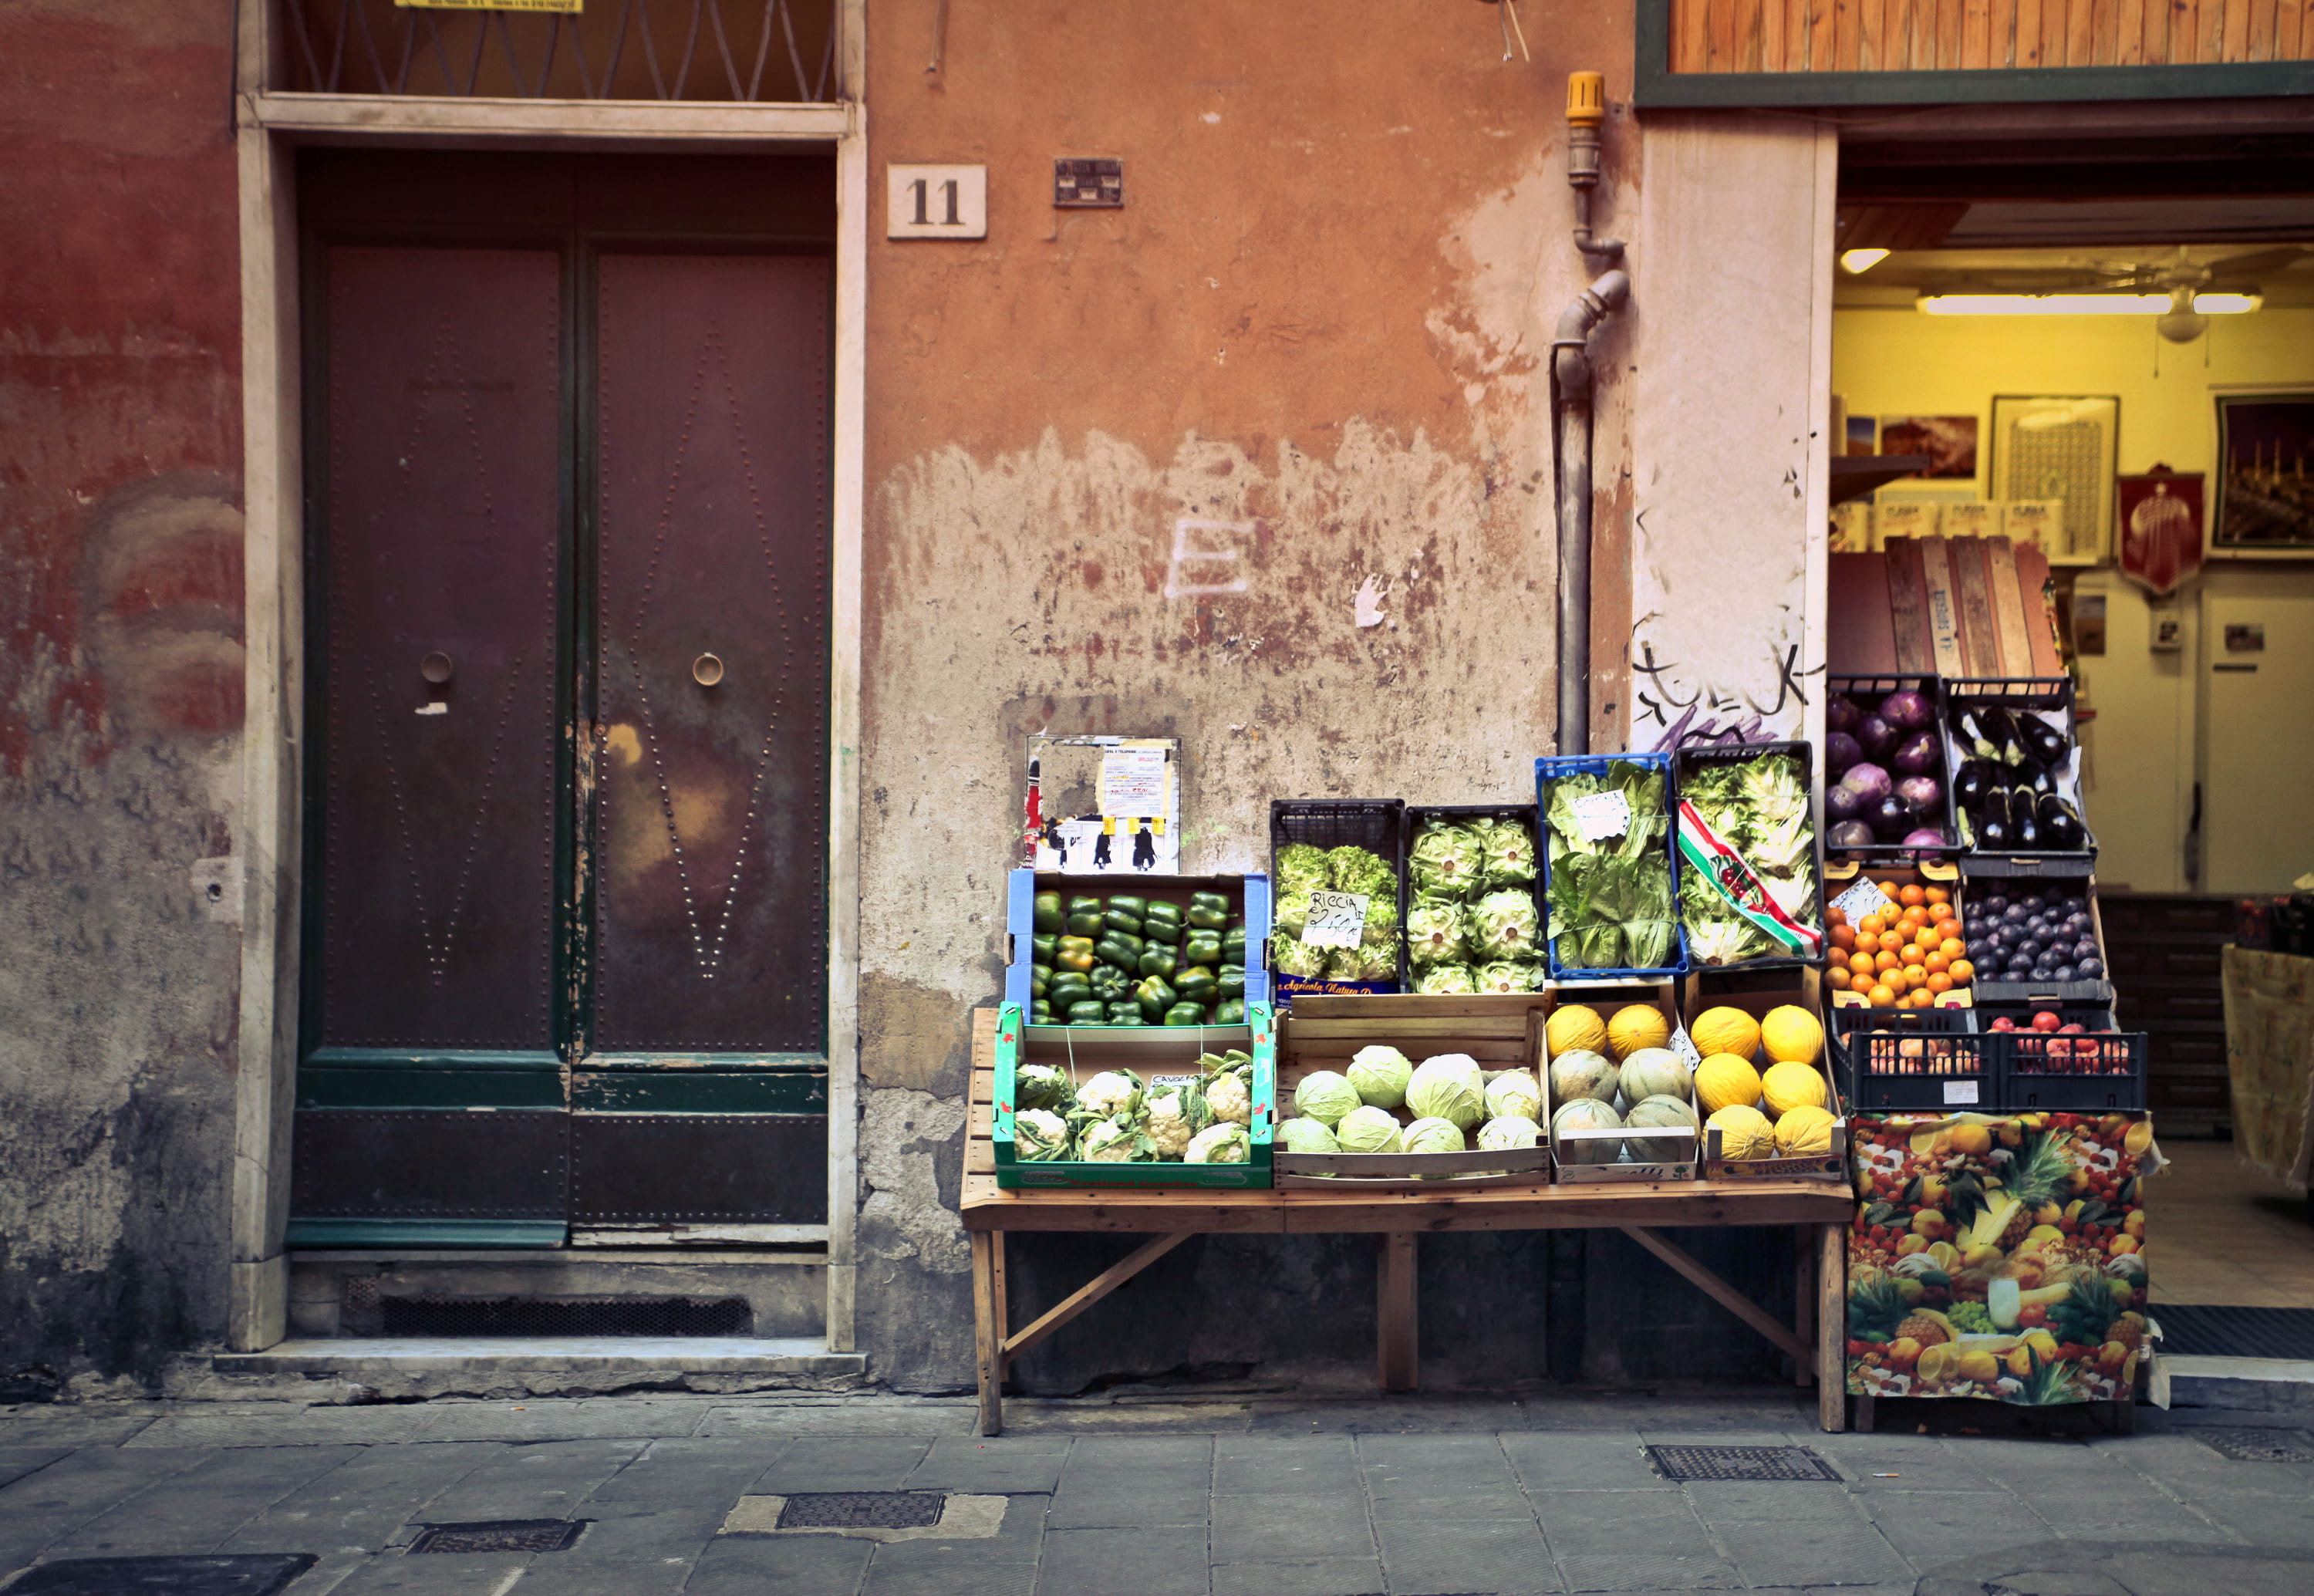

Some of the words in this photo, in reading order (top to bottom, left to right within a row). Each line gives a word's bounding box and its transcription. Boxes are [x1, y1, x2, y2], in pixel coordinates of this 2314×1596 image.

[906, 178, 965, 225] 11
[1164, 519, 1255, 599] E
[1283, 979, 1324, 992] Agricola
